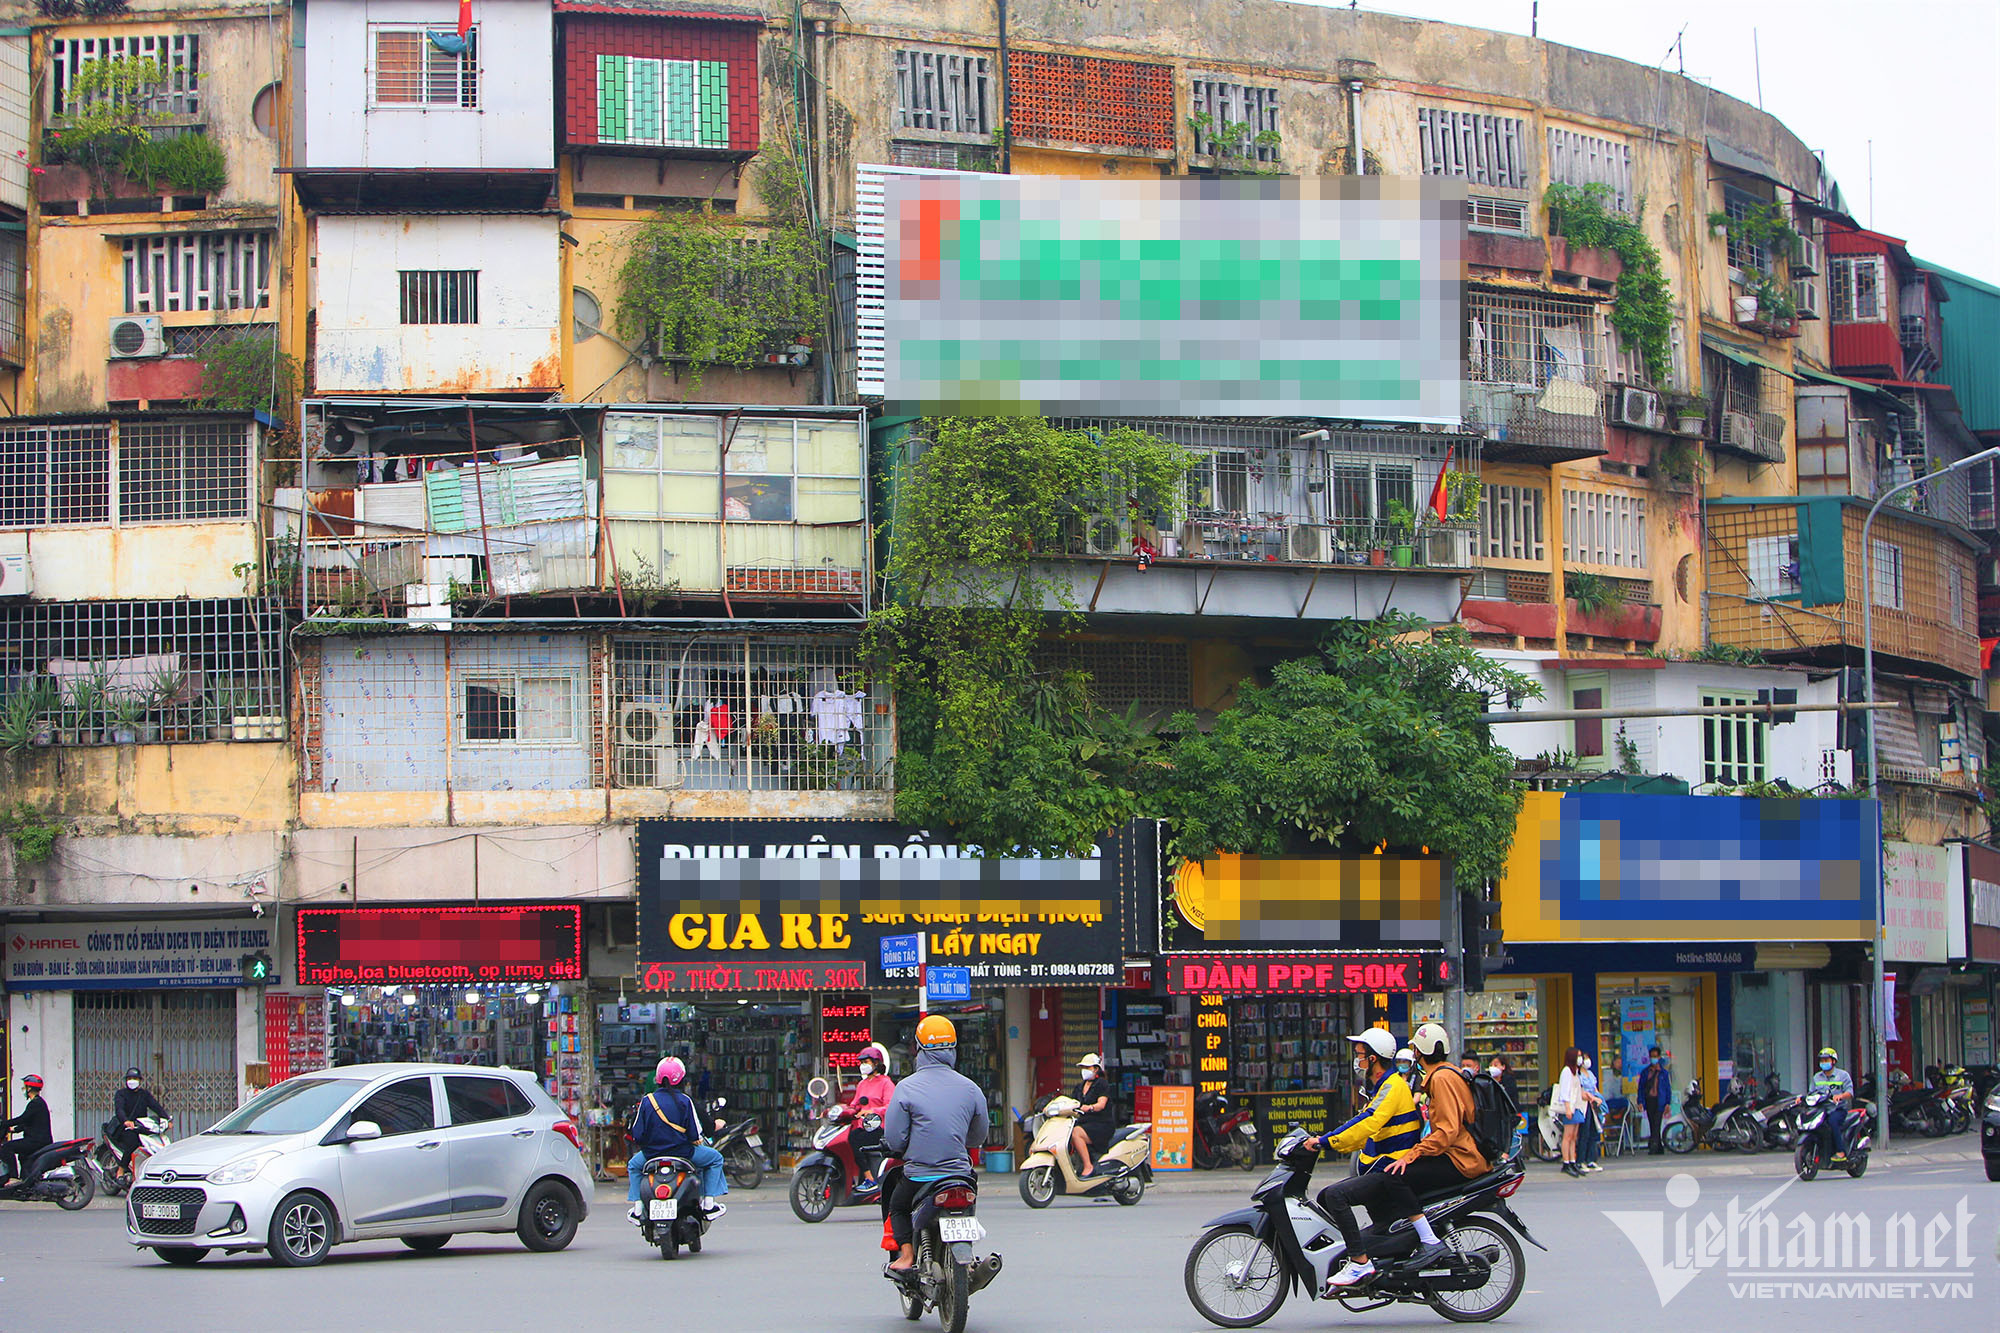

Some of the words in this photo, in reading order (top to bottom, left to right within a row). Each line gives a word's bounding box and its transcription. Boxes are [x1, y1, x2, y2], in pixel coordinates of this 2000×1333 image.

[29, 939, 81, 949] HANEL
[88, 930, 111, 952] CÔNG
[114, 933, 124, 951] TY
[167, 931, 189, 954] DỊCH
[190, 931, 201, 954] VỤ
[204, 927, 226, 953] ĐIỆN
[241, 930, 270, 948] HANEL
[931, 927, 974, 957] LẤY
[979, 932, 1042, 957] NGAY
[884, 950, 902, 963] ĐÔNG
[903, 948, 916, 961] TÁC
[643, 963, 676, 989] ỐP
[687, 964, 743, 989] THỜI
[755, 968, 814, 989] TRANG
[825, 968, 861, 989] 30K
[943, 970, 957, 978] PHỐ
[993, 962, 1021, 977] TÙNG
[1031, 964, 1048, 976] ĐT:
[1183, 960, 1257, 989] DÀN
[1268, 963, 1334, 989] PPF
[1343, 963, 1408, 989] 50K
[1197, 1010, 1228, 1028] CHỮA
[1207, 1032, 1221, 1050] ÉP
[1201, 1053, 1228, 1072] KÍNH
[1273, 1124, 1288, 1134] USB
[943, 1229, 977, 1240] 515.26
